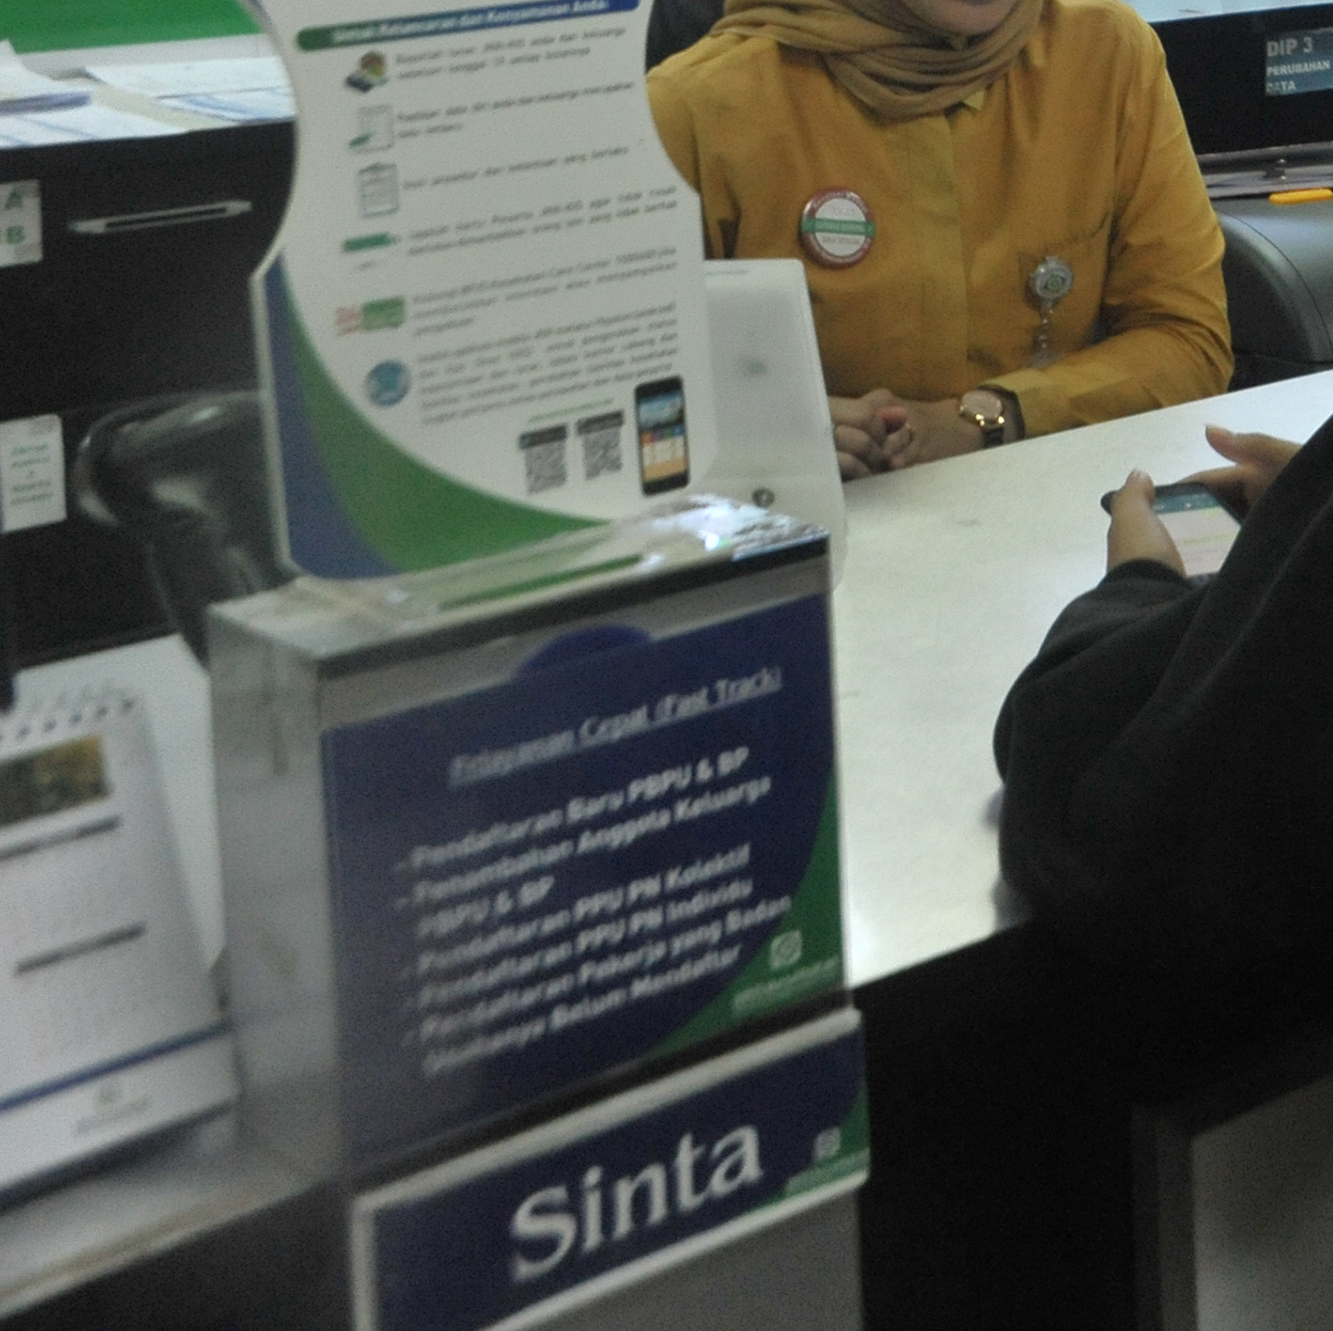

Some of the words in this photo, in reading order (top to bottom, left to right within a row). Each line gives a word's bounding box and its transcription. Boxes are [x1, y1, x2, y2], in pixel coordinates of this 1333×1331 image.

[1266, 38, 1298, 58] DIP
[1302, 36, 1313, 53] 3
[1266, 60, 1331, 76] PERUBAHAN
[673, 776, 772, 823] Keluarga
[509, 1121, 765, 1282] Sinta
